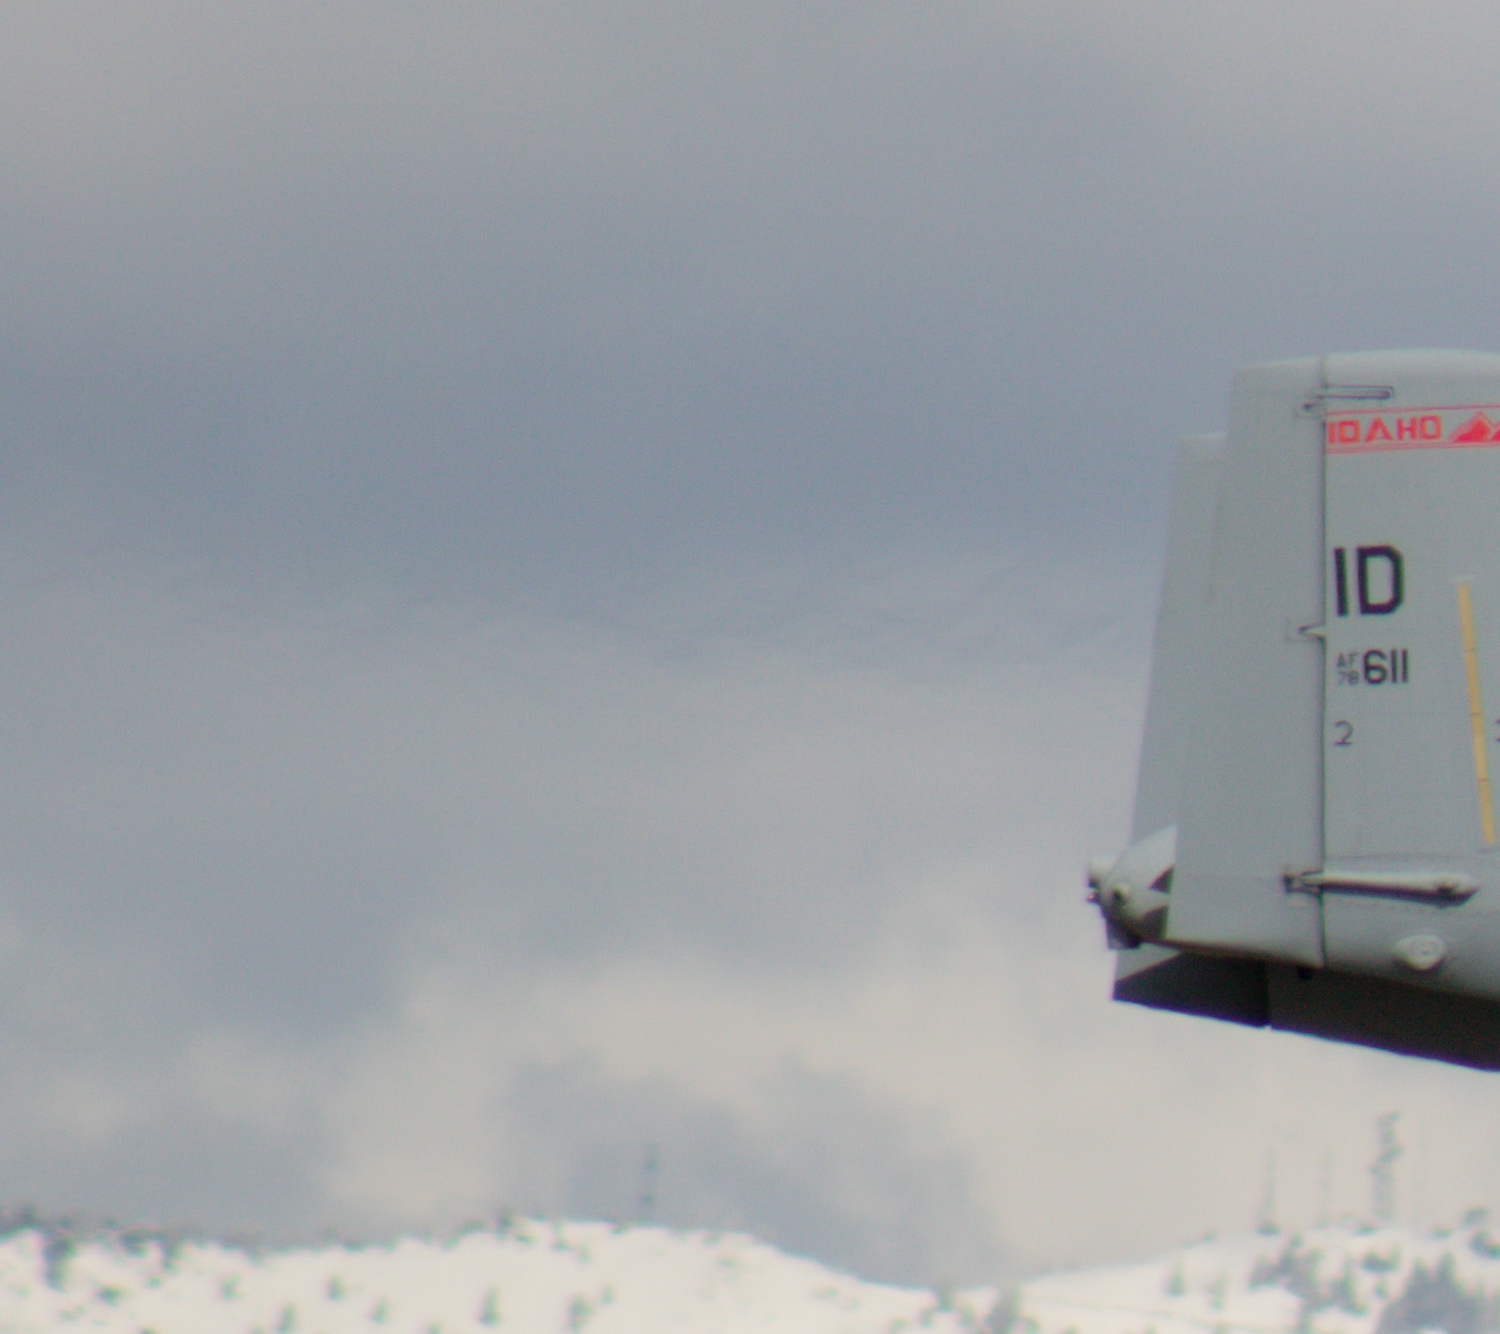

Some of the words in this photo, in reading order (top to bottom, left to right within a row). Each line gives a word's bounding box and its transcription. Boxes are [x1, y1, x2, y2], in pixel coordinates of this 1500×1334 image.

[1328, 415, 1442, 444] IDAHO
[1334, 545, 1404, 616] ID
[1363, 649, 1408, 684] 611
[1334, 720, 1354, 746] 2
